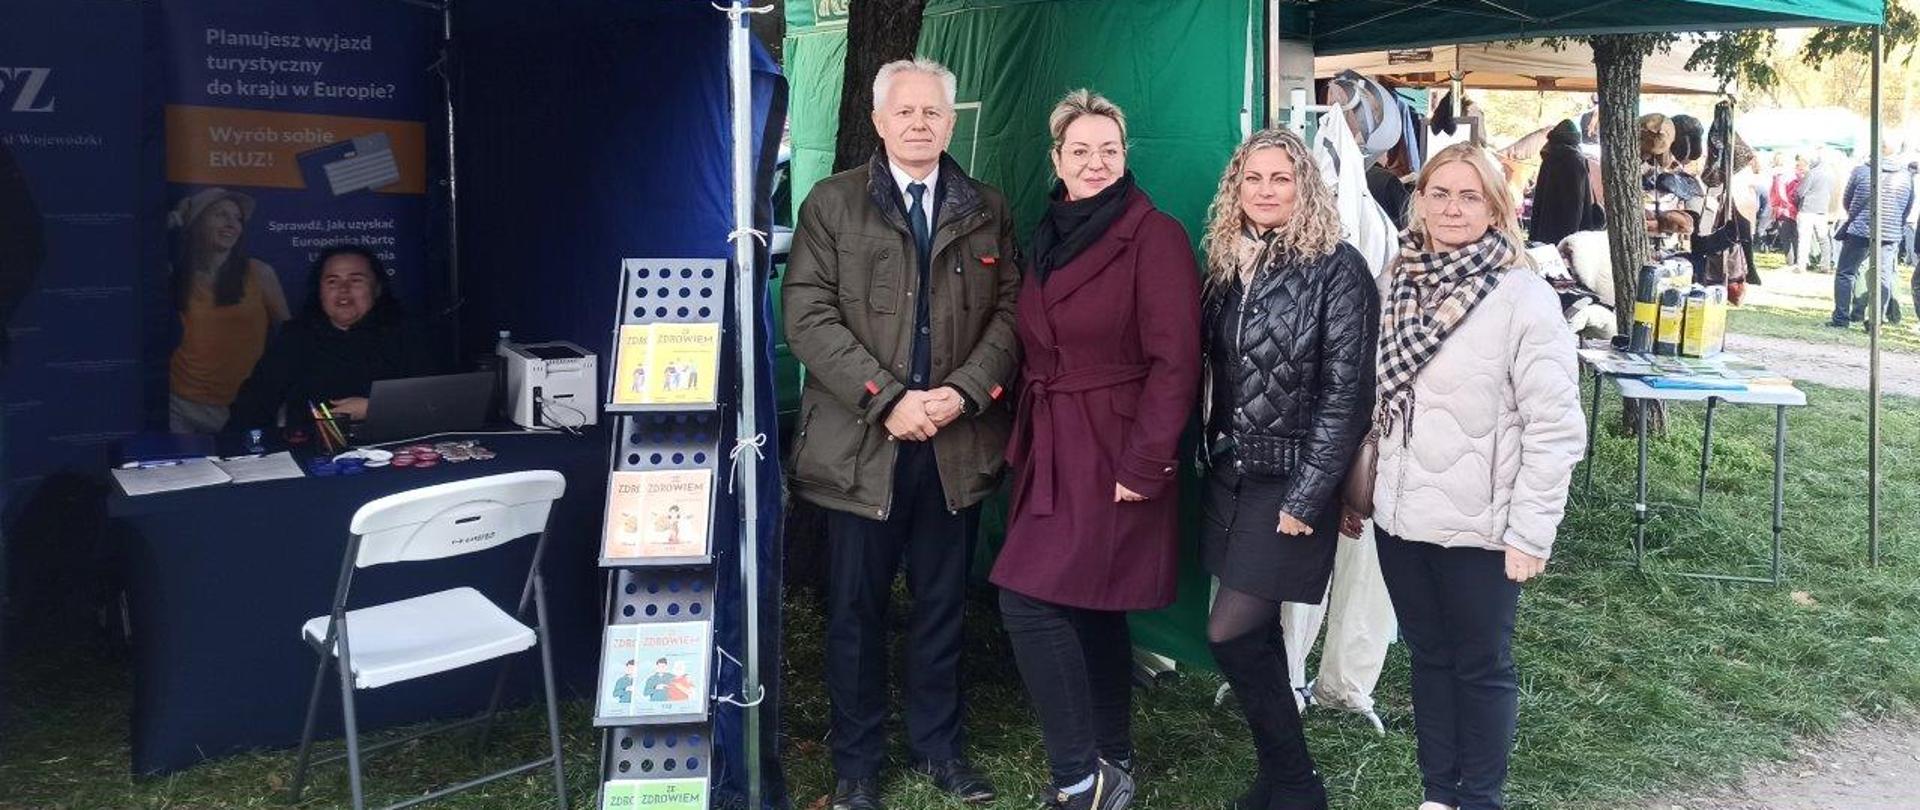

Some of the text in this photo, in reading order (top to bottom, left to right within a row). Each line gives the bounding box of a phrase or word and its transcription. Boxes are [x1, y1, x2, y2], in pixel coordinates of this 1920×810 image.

[205, 28, 372, 52] Planujesz wyjazd
[206, 54, 323, 75] turystyczny
[206, 80, 396, 101] do kraju w Europie?
[209, 126, 335, 146] Wyrób sobie
[209, 151, 274, 168] EKUZ!
[268, 218, 395, 232] Sprawdź, jak uzyskać
[361, 235, 396, 247] Kartę
[657, 334, 713, 345] ZDROWIEM
[646, 482, 704, 493] ZDROWIEM
[643, 635, 702, 647] ZDROWIEM
[641, 792, 700, 805] ZDROWIEM
